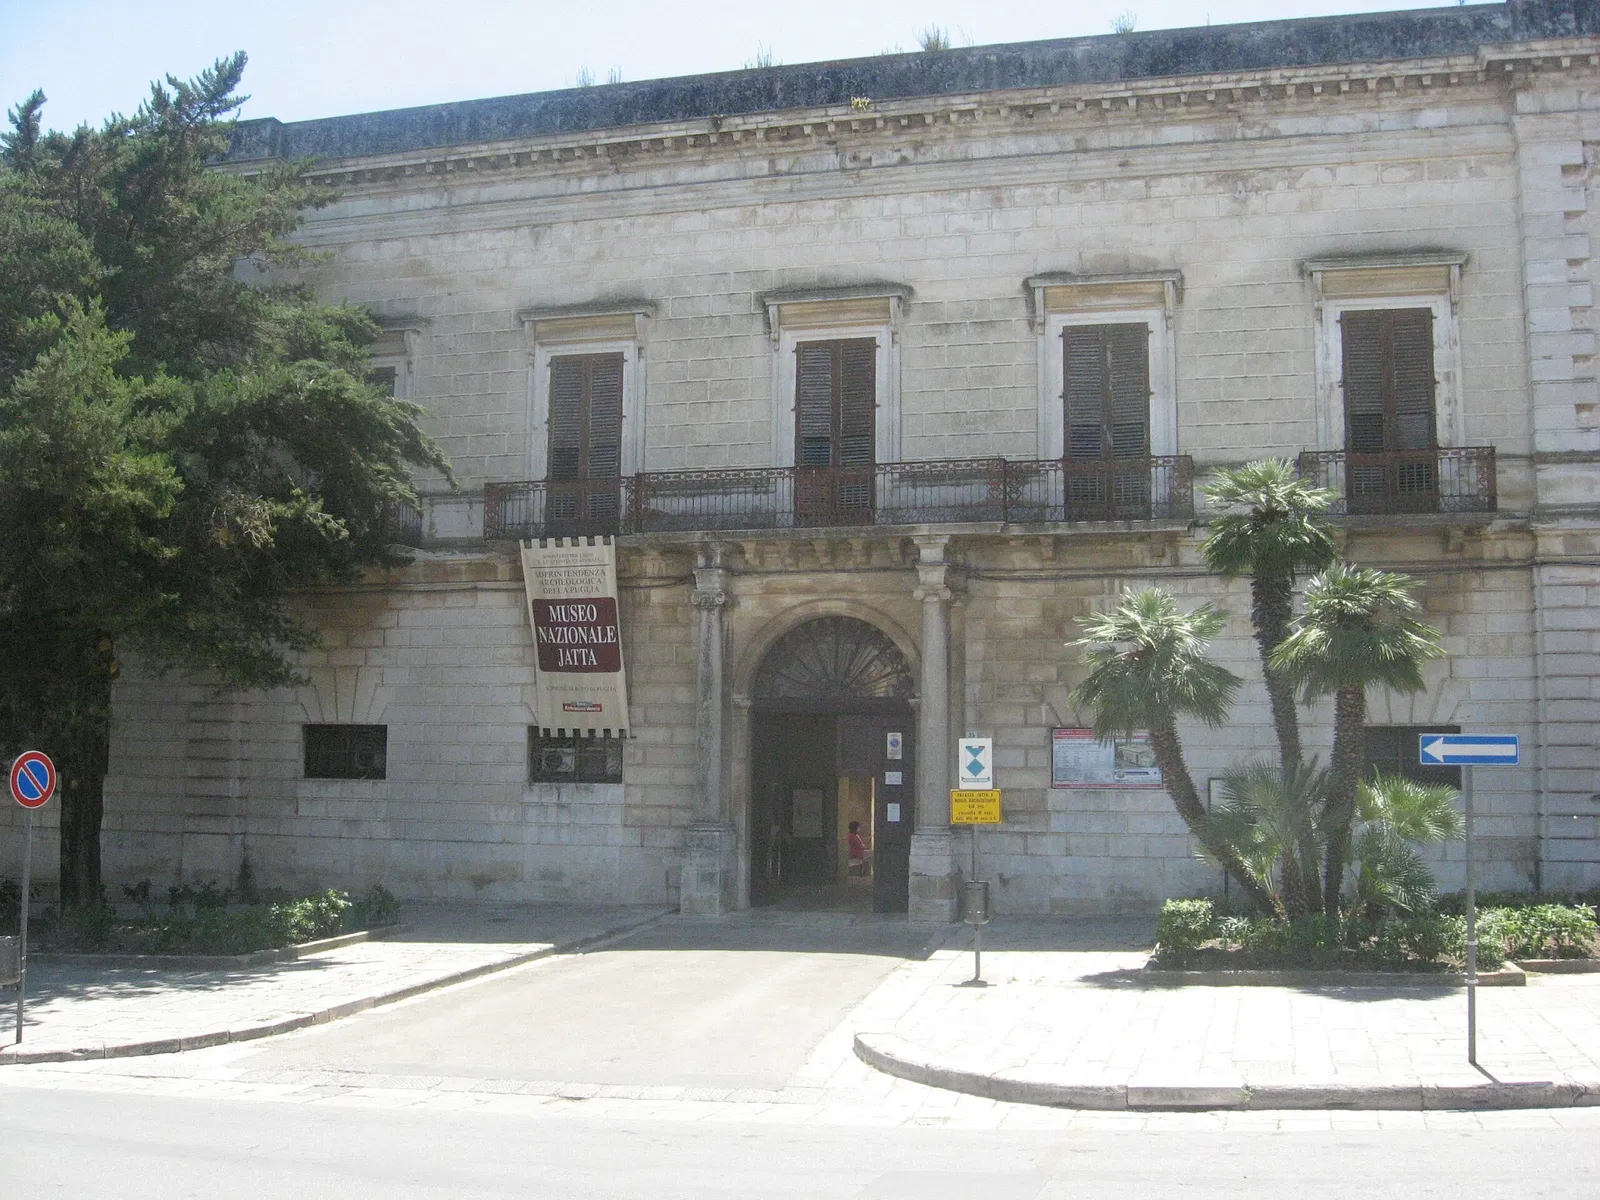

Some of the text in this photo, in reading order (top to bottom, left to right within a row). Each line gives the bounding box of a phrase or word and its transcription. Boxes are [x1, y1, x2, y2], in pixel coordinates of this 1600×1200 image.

[535, 569, 606, 578] SOPRINTENDENZA
[540, 578, 602, 587] ARCHEOLOGICA
[542, 586, 600, 595] DELLA PUGLIA
[548, 604, 598, 623] MUSEO
[538, 625, 617, 644] NAZIONALE
[558, 648, 598, 667] JATTA
